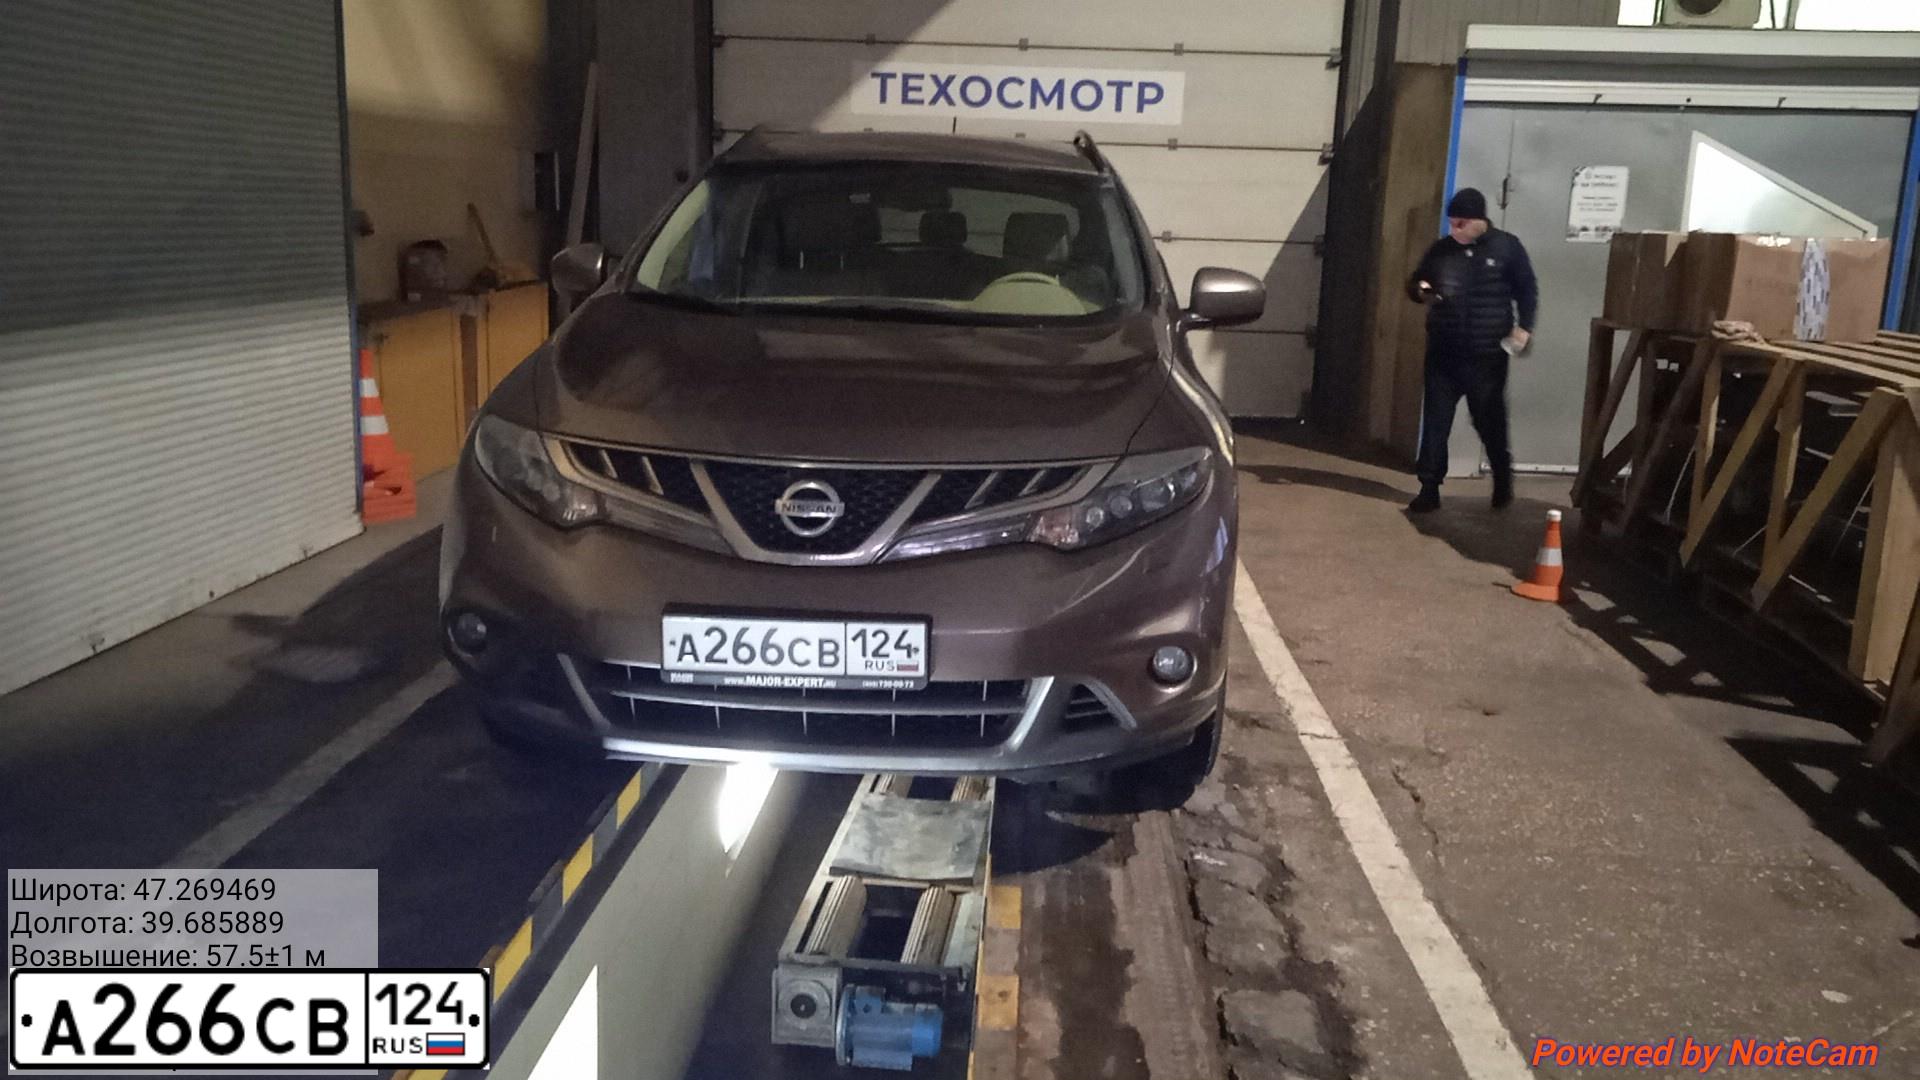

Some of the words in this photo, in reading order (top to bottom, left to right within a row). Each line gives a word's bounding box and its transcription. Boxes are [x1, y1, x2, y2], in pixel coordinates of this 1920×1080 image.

[871, 72, 1165, 113] ТЕХОСМОТР
[781, 502, 837, 513] NISSAN
[676, 626, 840, 668] А266СВ
[852, 629, 912, 658] 124
[865, 660, 895, 672] RUS
